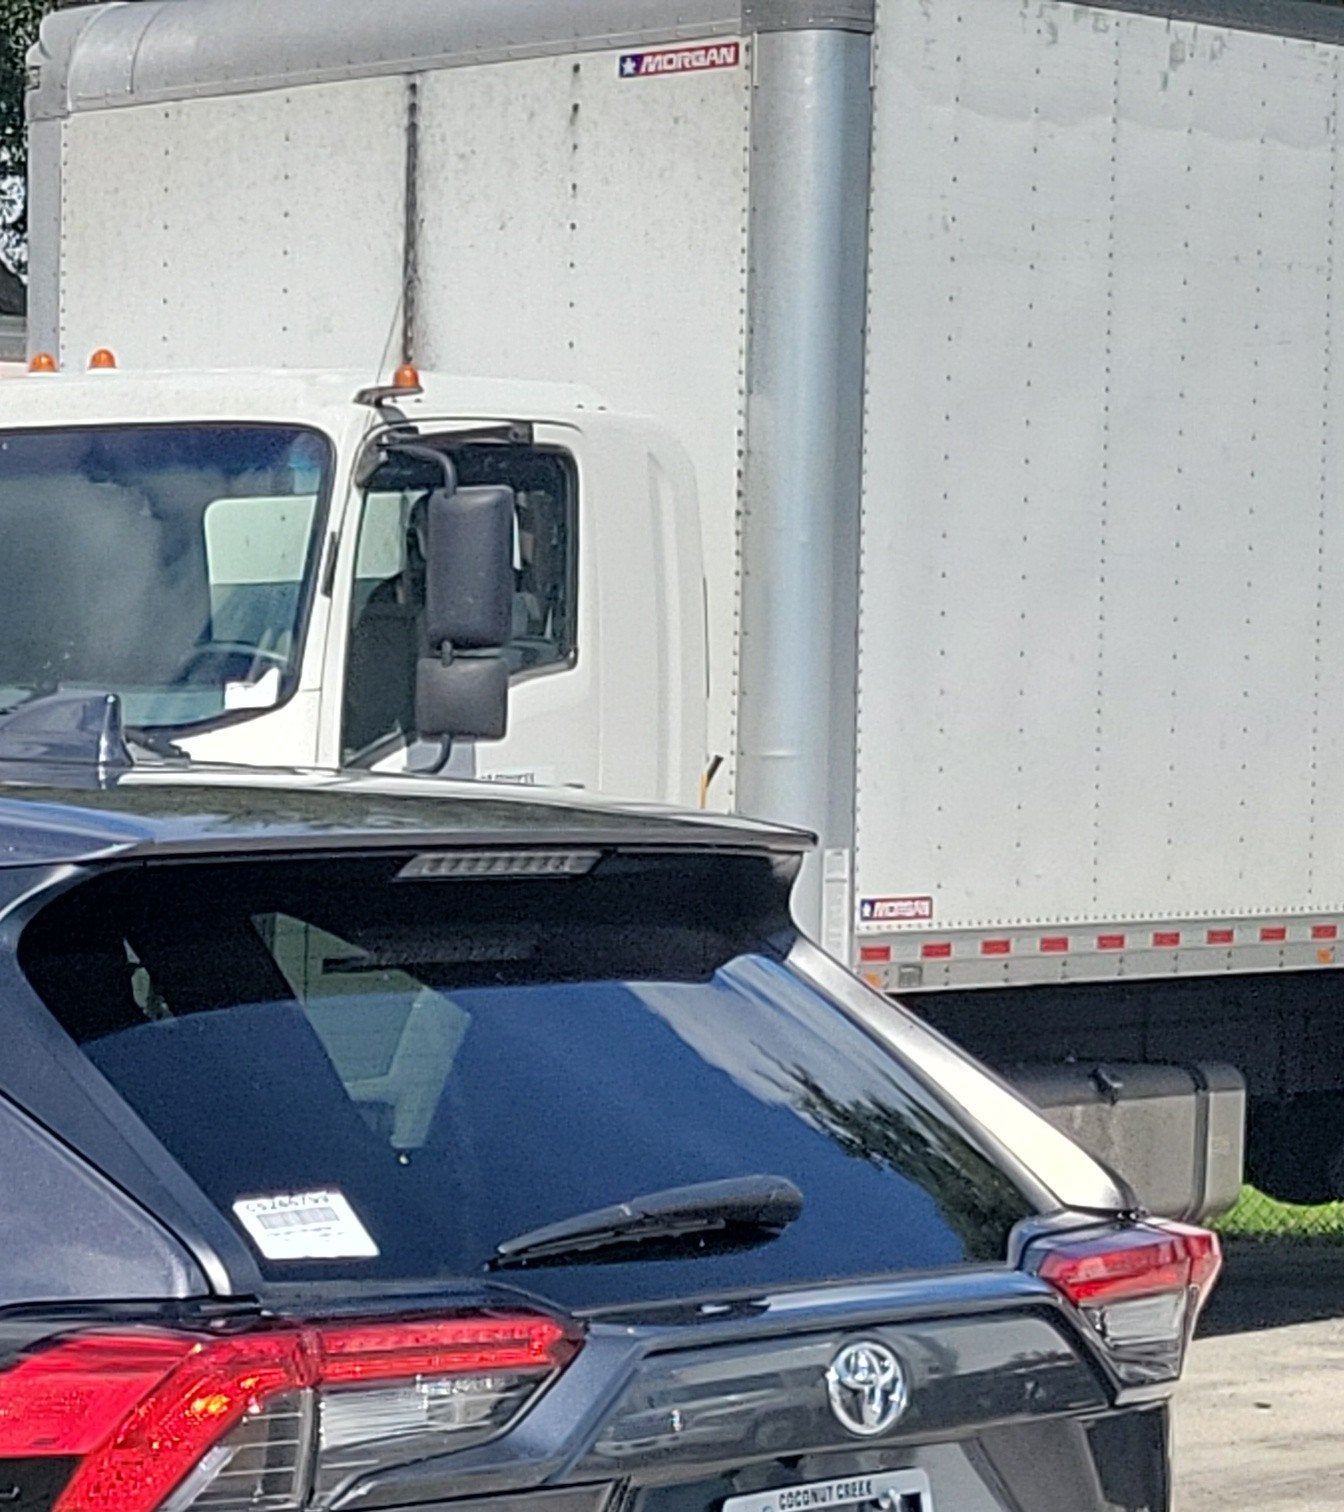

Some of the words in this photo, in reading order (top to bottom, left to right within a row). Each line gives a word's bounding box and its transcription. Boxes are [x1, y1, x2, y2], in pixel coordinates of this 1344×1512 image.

[639, 45, 736, 74] MORGAN
[778, 1485, 833, 1510] COCONUT
[835, 1479, 873, 1500] CREEK
